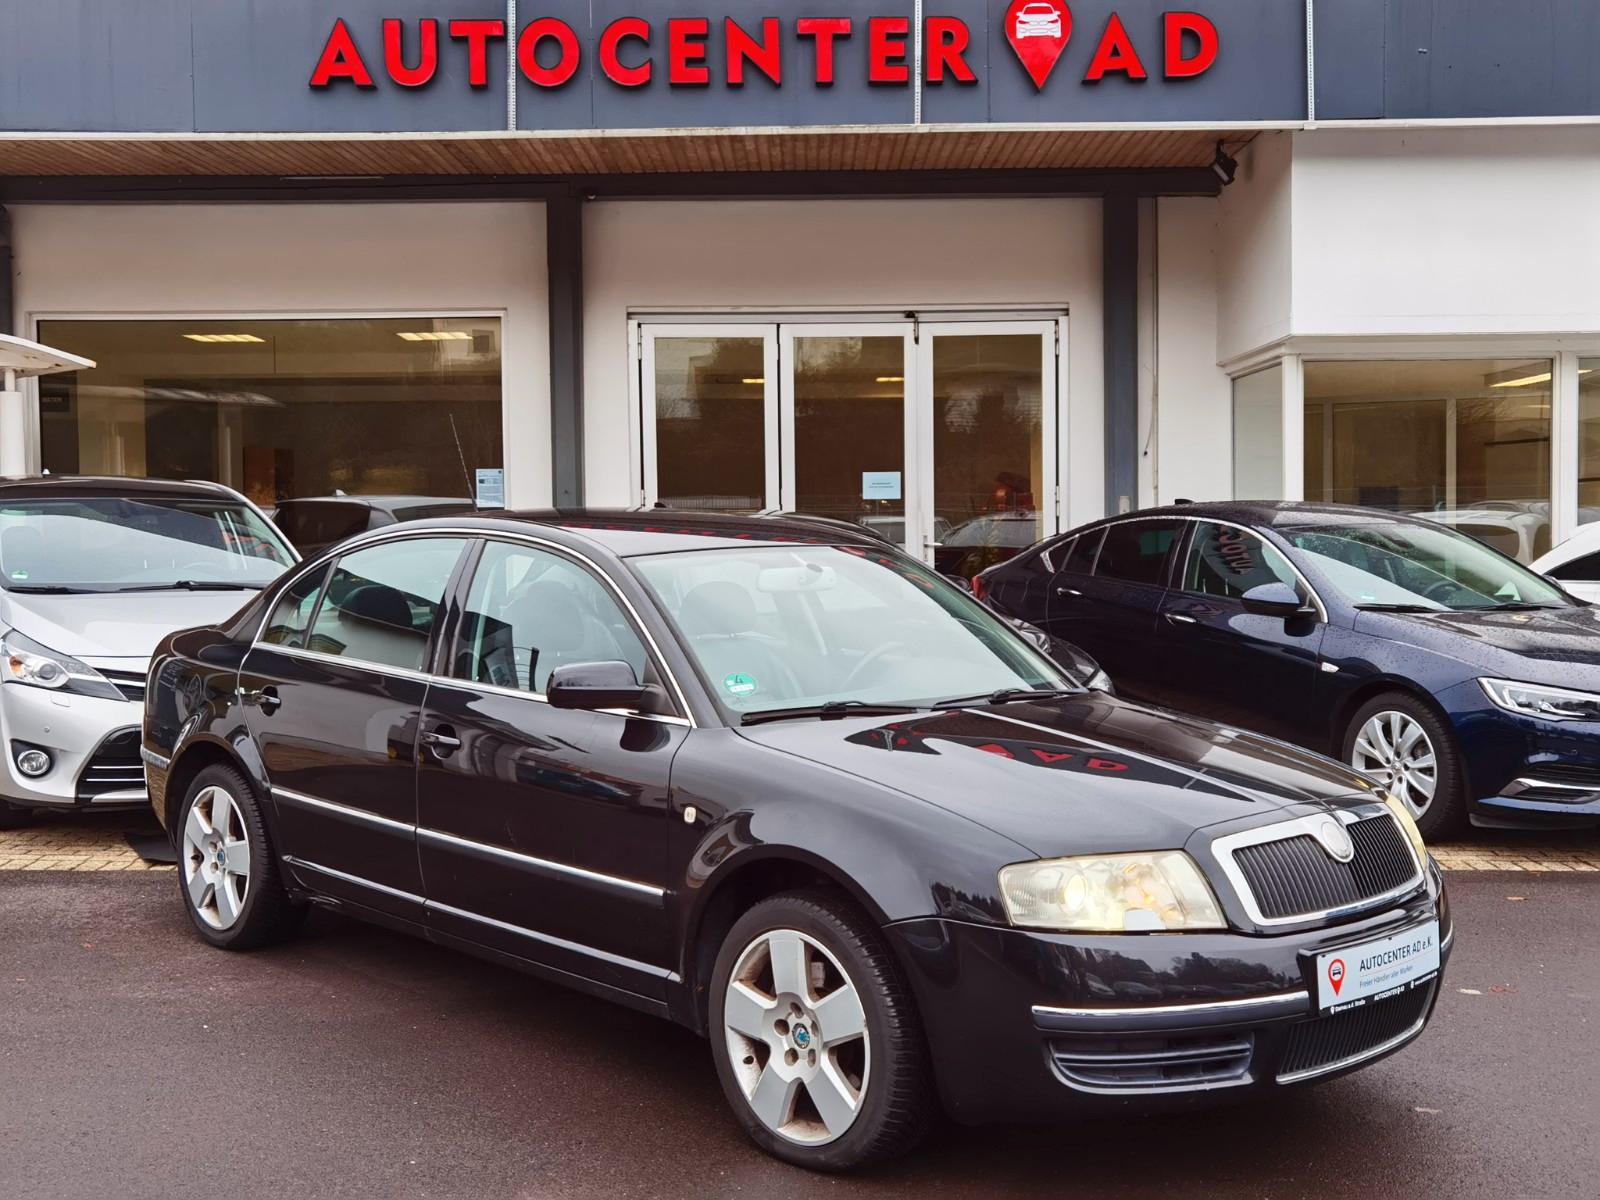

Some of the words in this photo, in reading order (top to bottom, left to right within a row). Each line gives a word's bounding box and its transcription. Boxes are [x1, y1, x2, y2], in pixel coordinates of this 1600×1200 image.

[310, 17, 977, 89] AUTOCENTER
[1085, 12, 1219, 80] AD
[1360, 946, 1411, 972] AUTOCENTER
[1412, 941, 1422, 954] AD
